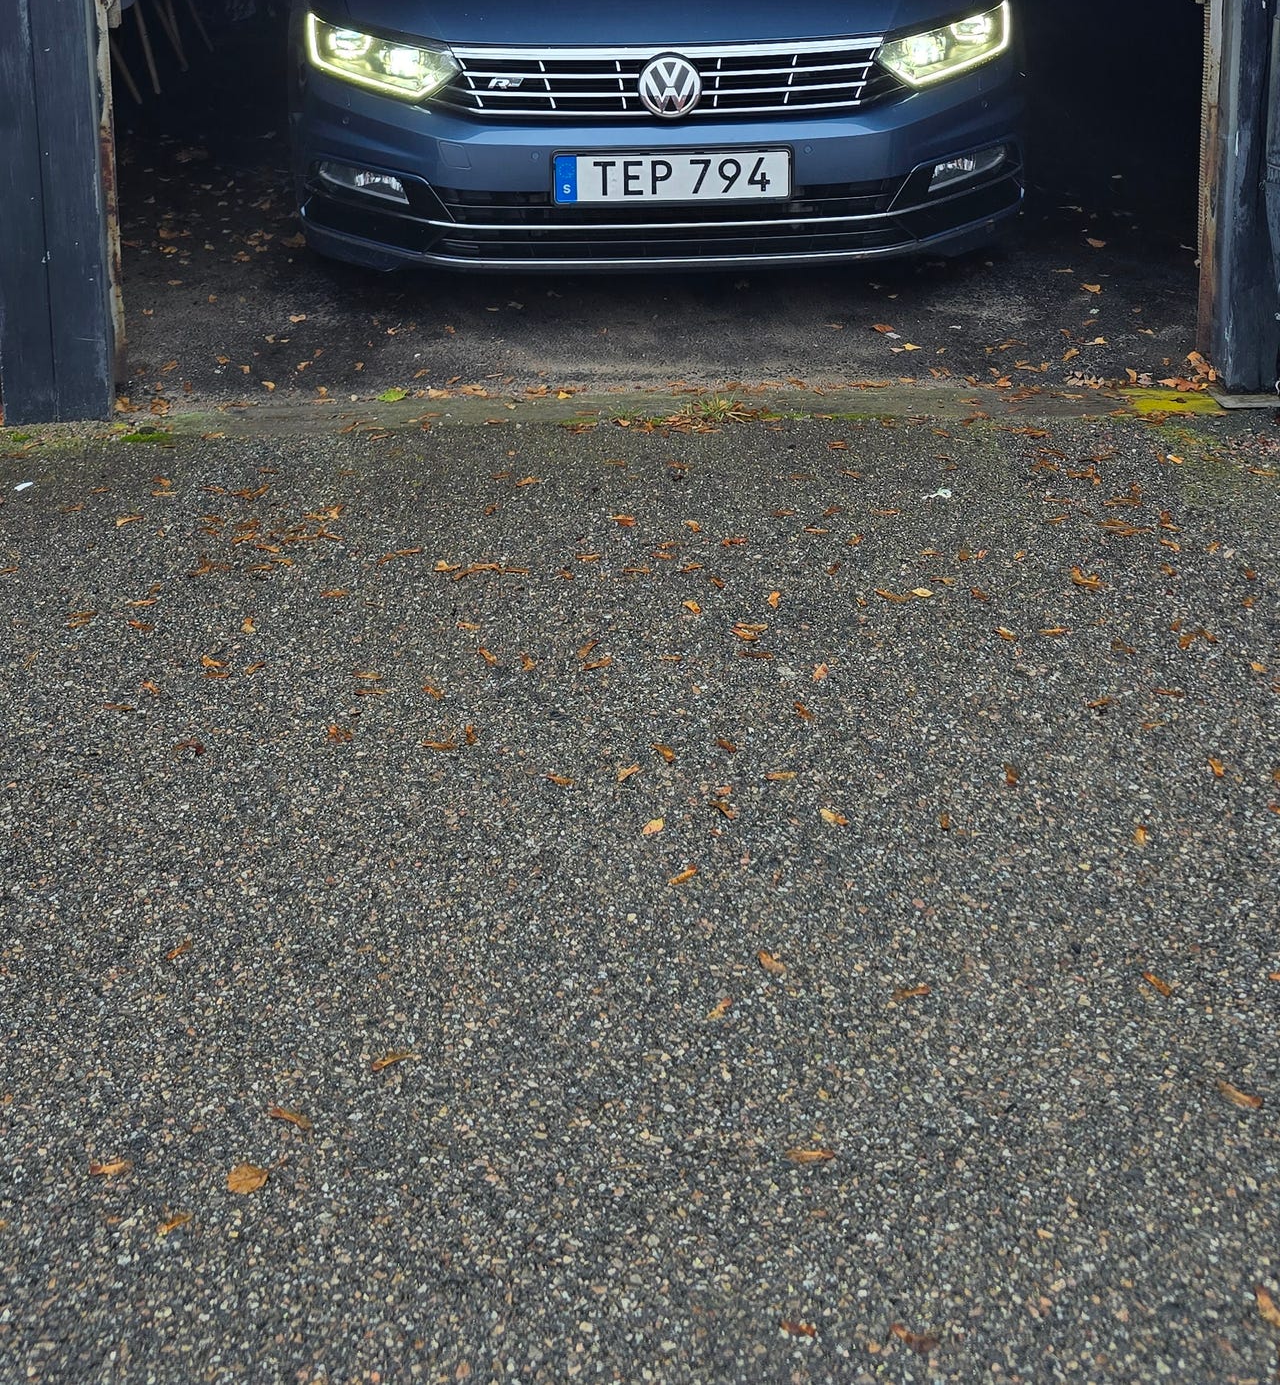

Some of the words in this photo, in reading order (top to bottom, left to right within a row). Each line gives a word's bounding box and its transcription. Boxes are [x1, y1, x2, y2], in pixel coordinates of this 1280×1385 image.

[642, 58, 698, 114] VW
[563, 183, 572, 194] S
[593, 160, 673, 196] TEP
[689, 157, 771, 194] 794
